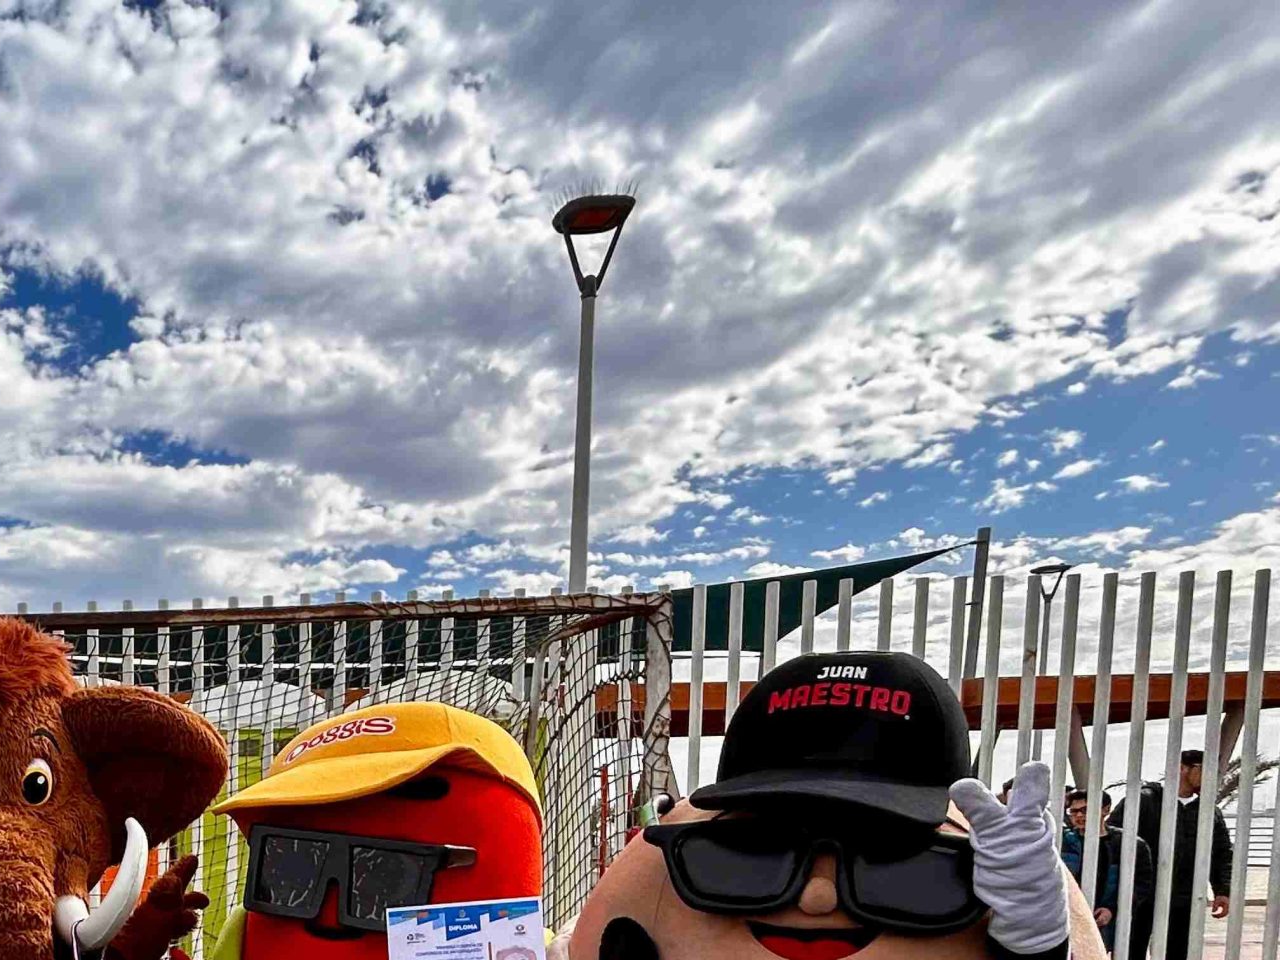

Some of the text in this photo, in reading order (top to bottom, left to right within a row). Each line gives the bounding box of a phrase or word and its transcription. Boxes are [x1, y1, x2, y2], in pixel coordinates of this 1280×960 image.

[817, 665, 868, 679] JUAN
[767, 682, 911, 715] MAESTRO
[448, 923, 478, 932] DIPLOMA
